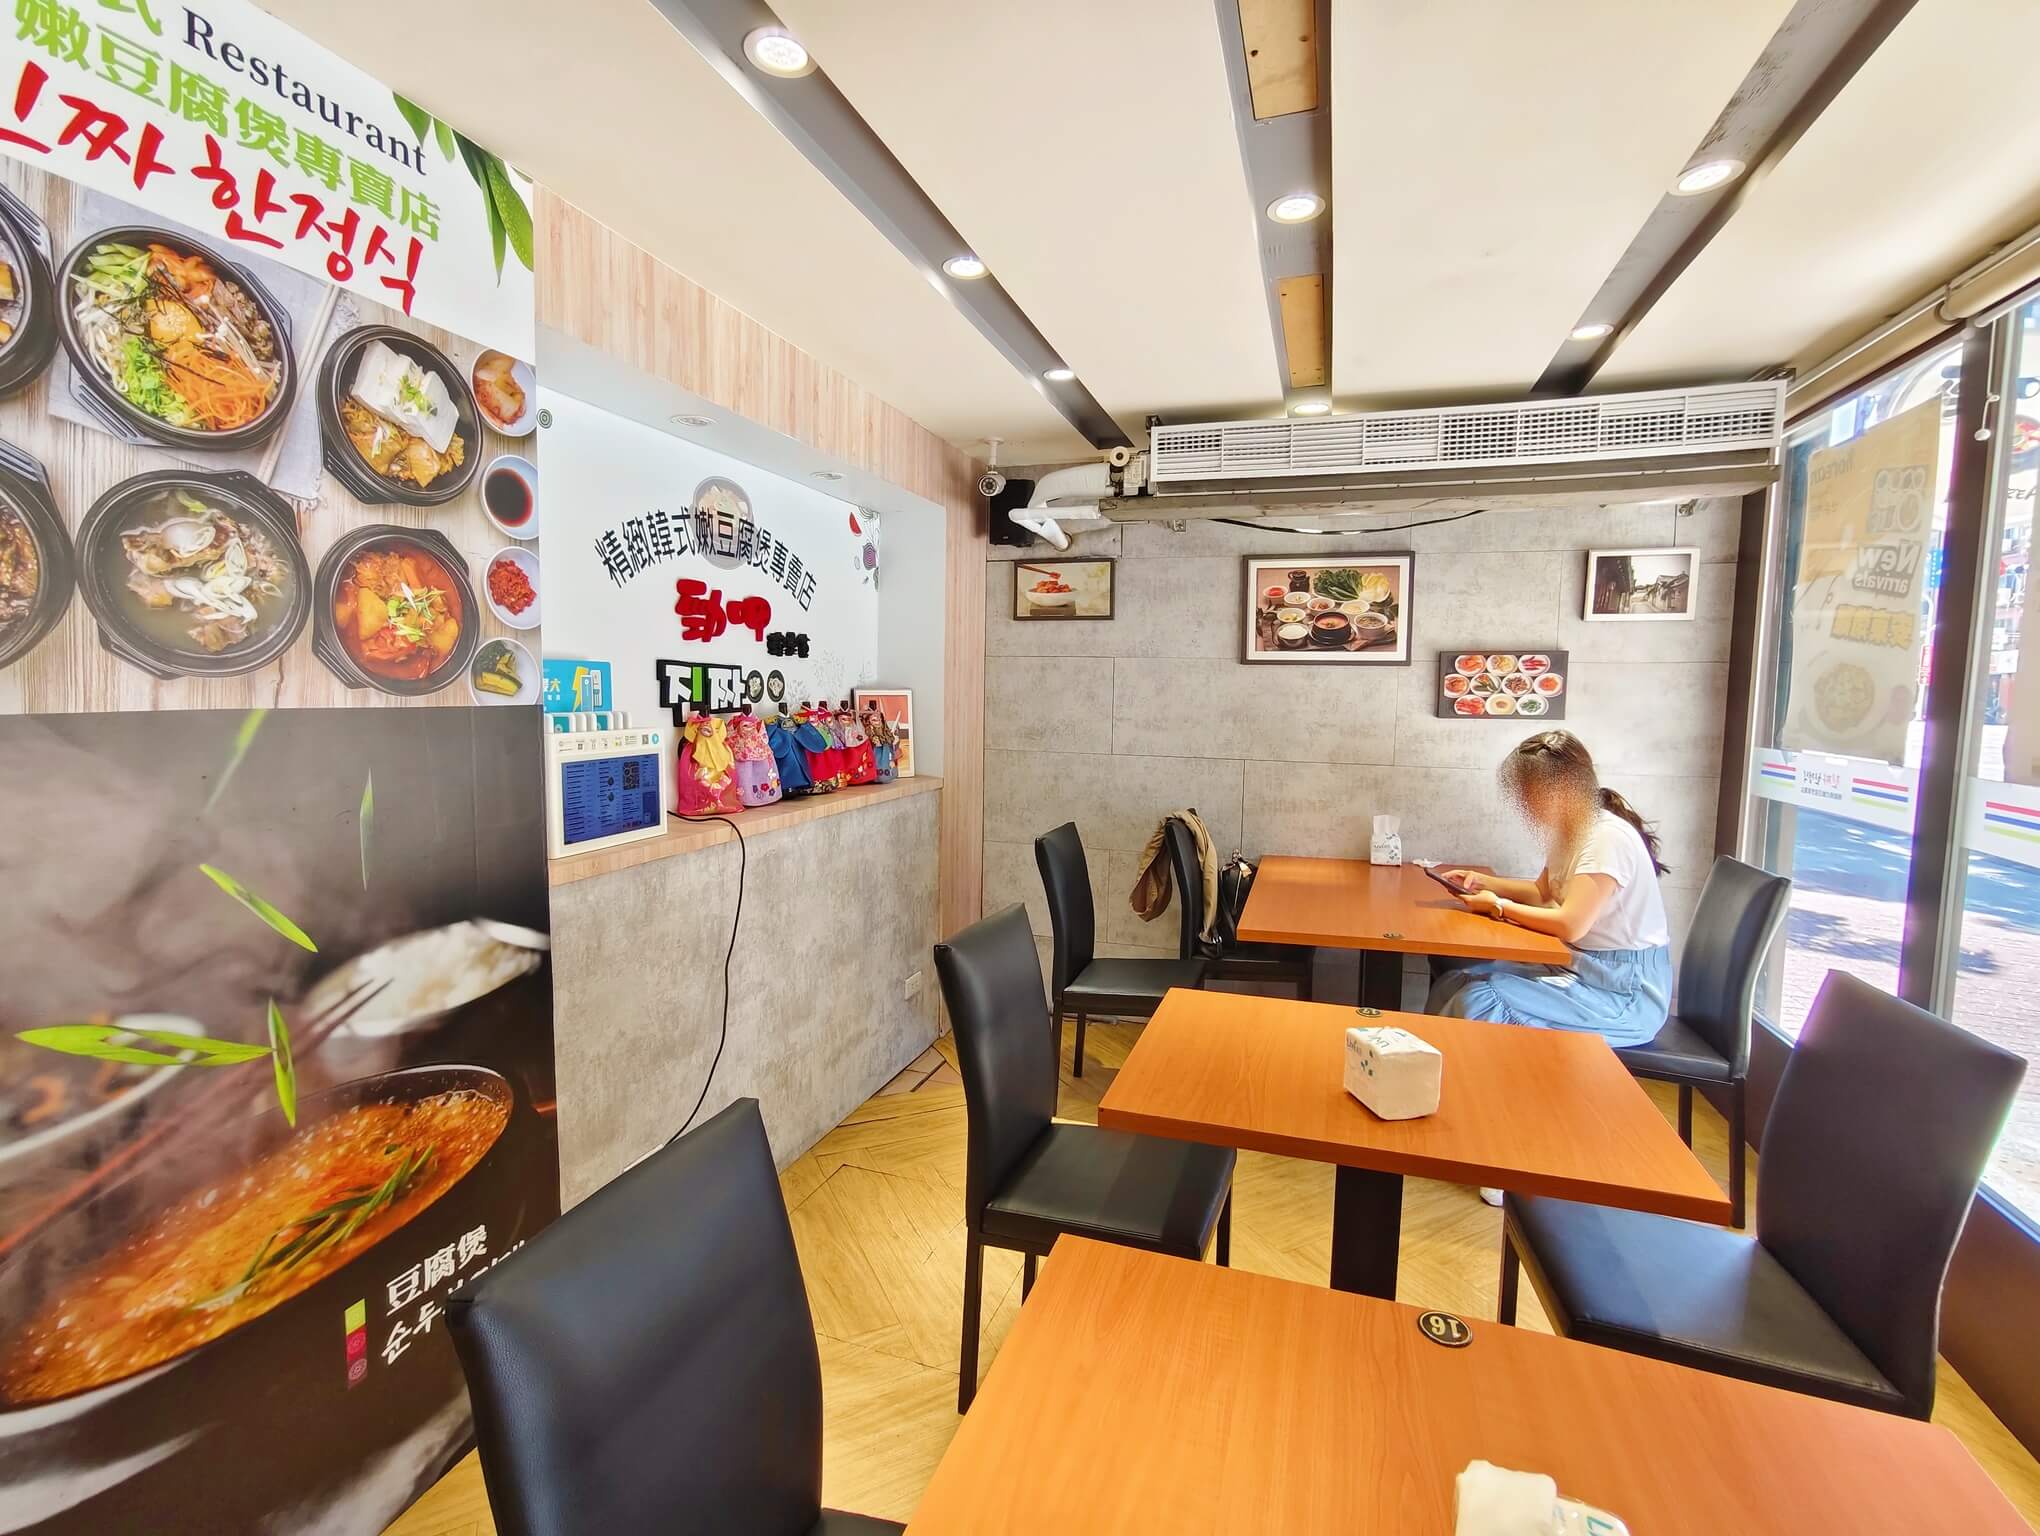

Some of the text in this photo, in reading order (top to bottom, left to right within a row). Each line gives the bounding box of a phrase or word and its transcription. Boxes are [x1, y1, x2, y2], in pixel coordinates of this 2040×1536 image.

[15, 0, 441, 242] 嫩豆腐煲專賣店
[182, 6, 427, 176] Restaurant
[191, 133, 424, 317] 한정식
[595, 506, 817, 612] 精緻韓式嫩豆腐煲專賣店
[386, 1224, 487, 1316] 豆腐煲
[1429, 1316, 1461, 1338] 16
